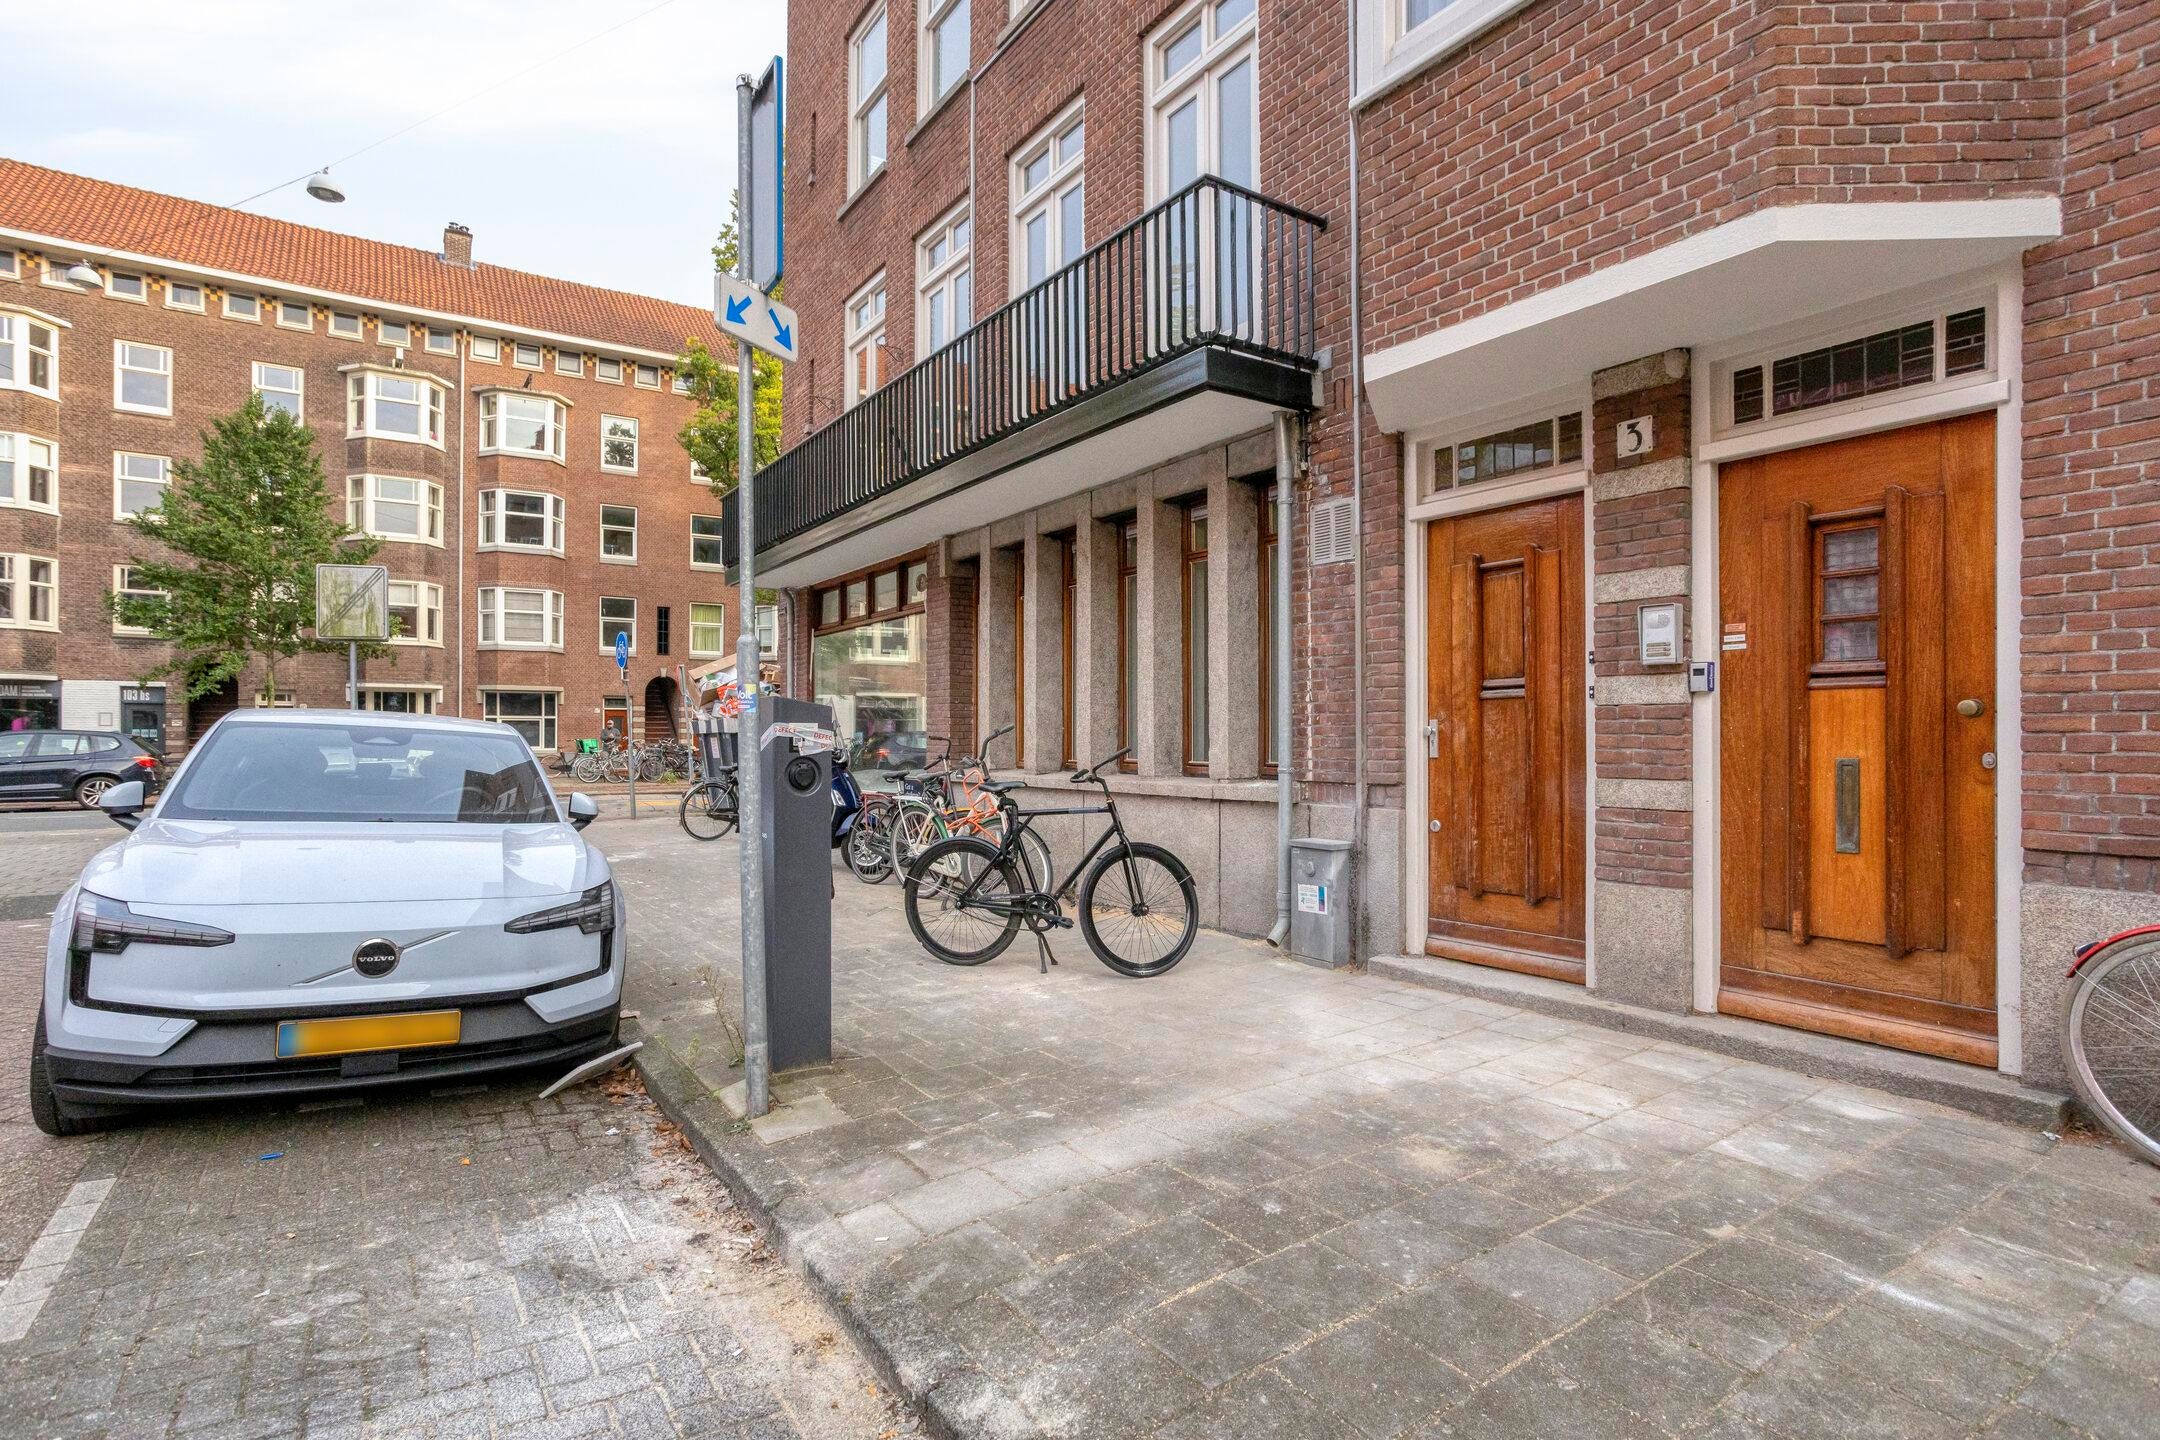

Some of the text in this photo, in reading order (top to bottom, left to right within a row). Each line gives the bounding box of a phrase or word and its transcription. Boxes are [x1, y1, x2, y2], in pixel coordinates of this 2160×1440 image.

[1626, 421, 1642, 452] 3
[123, 689, 138, 701] 103
[813, 732, 832, 741] DEFEC
